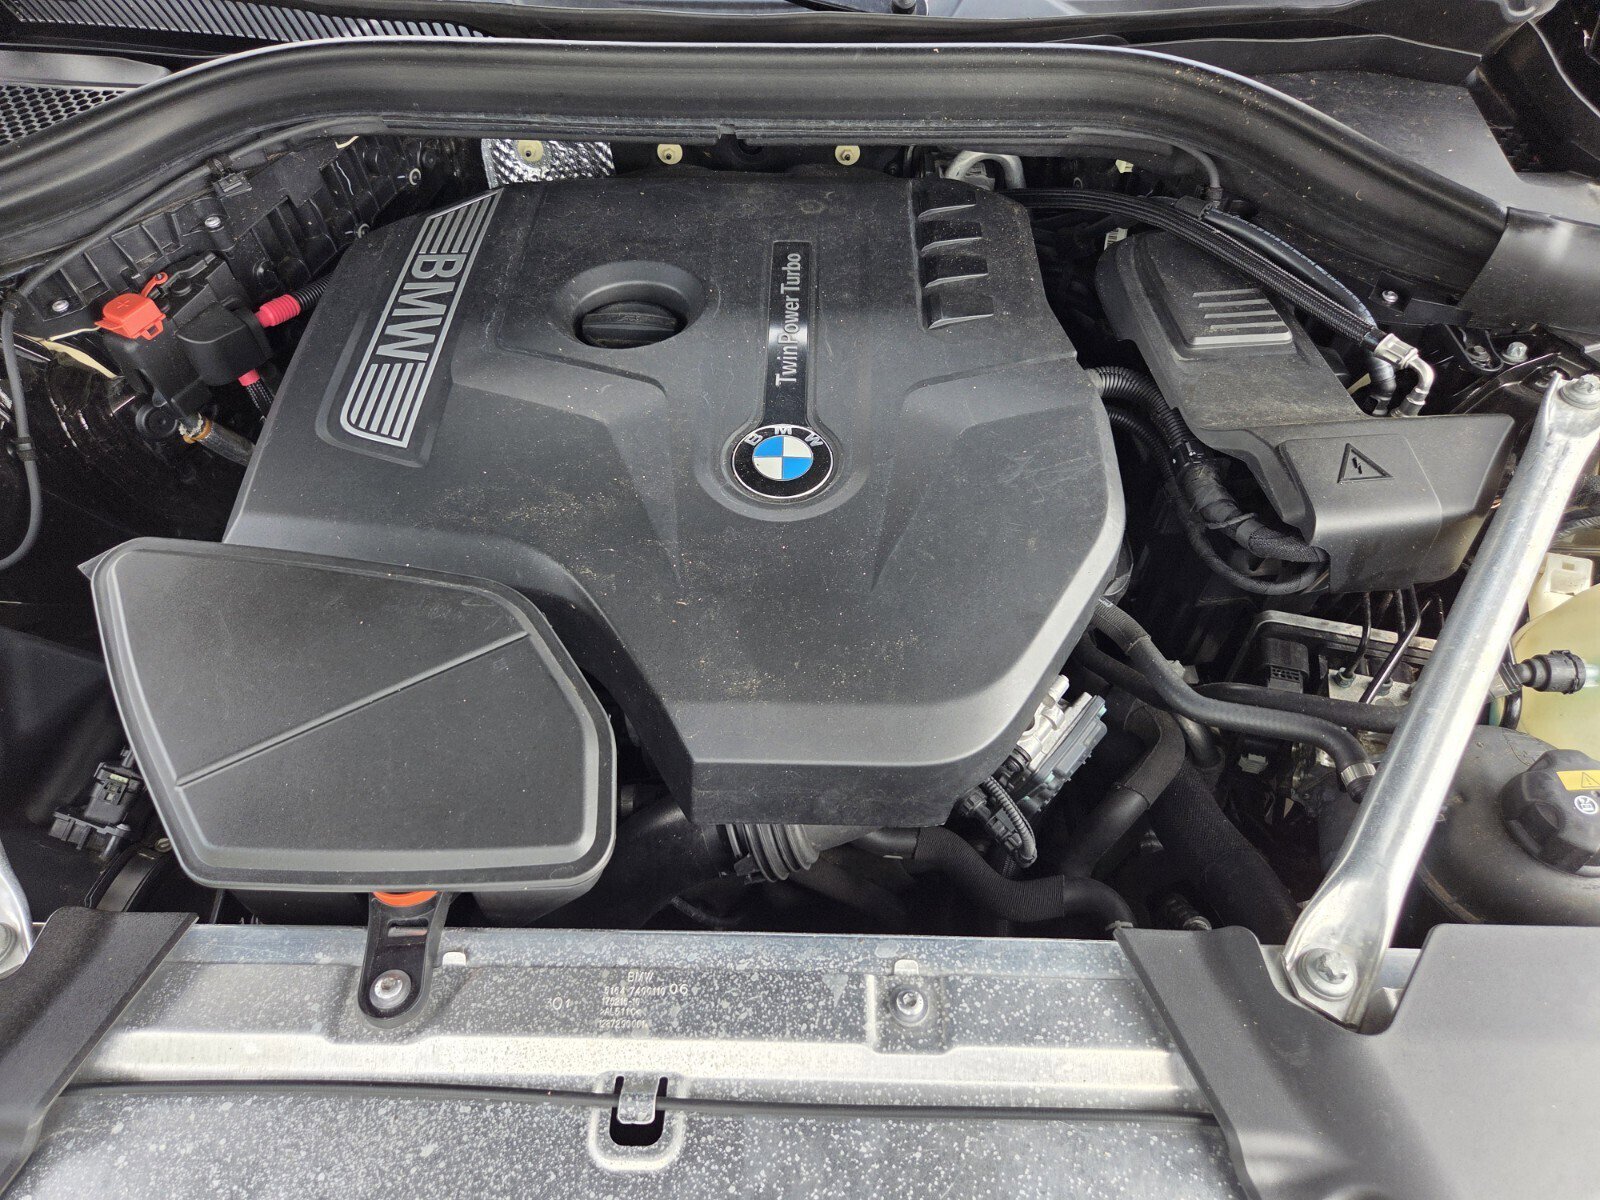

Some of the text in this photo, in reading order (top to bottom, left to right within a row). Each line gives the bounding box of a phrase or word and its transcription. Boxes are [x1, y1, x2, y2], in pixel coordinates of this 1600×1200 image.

[375, 253, 467, 362] BMW
[775, 252, 802, 387] TwinPower Turbo
[744, 424, 824, 447] BMW
[627, 971, 654, 983] BMW
[669, 983, 689, 995] 06
